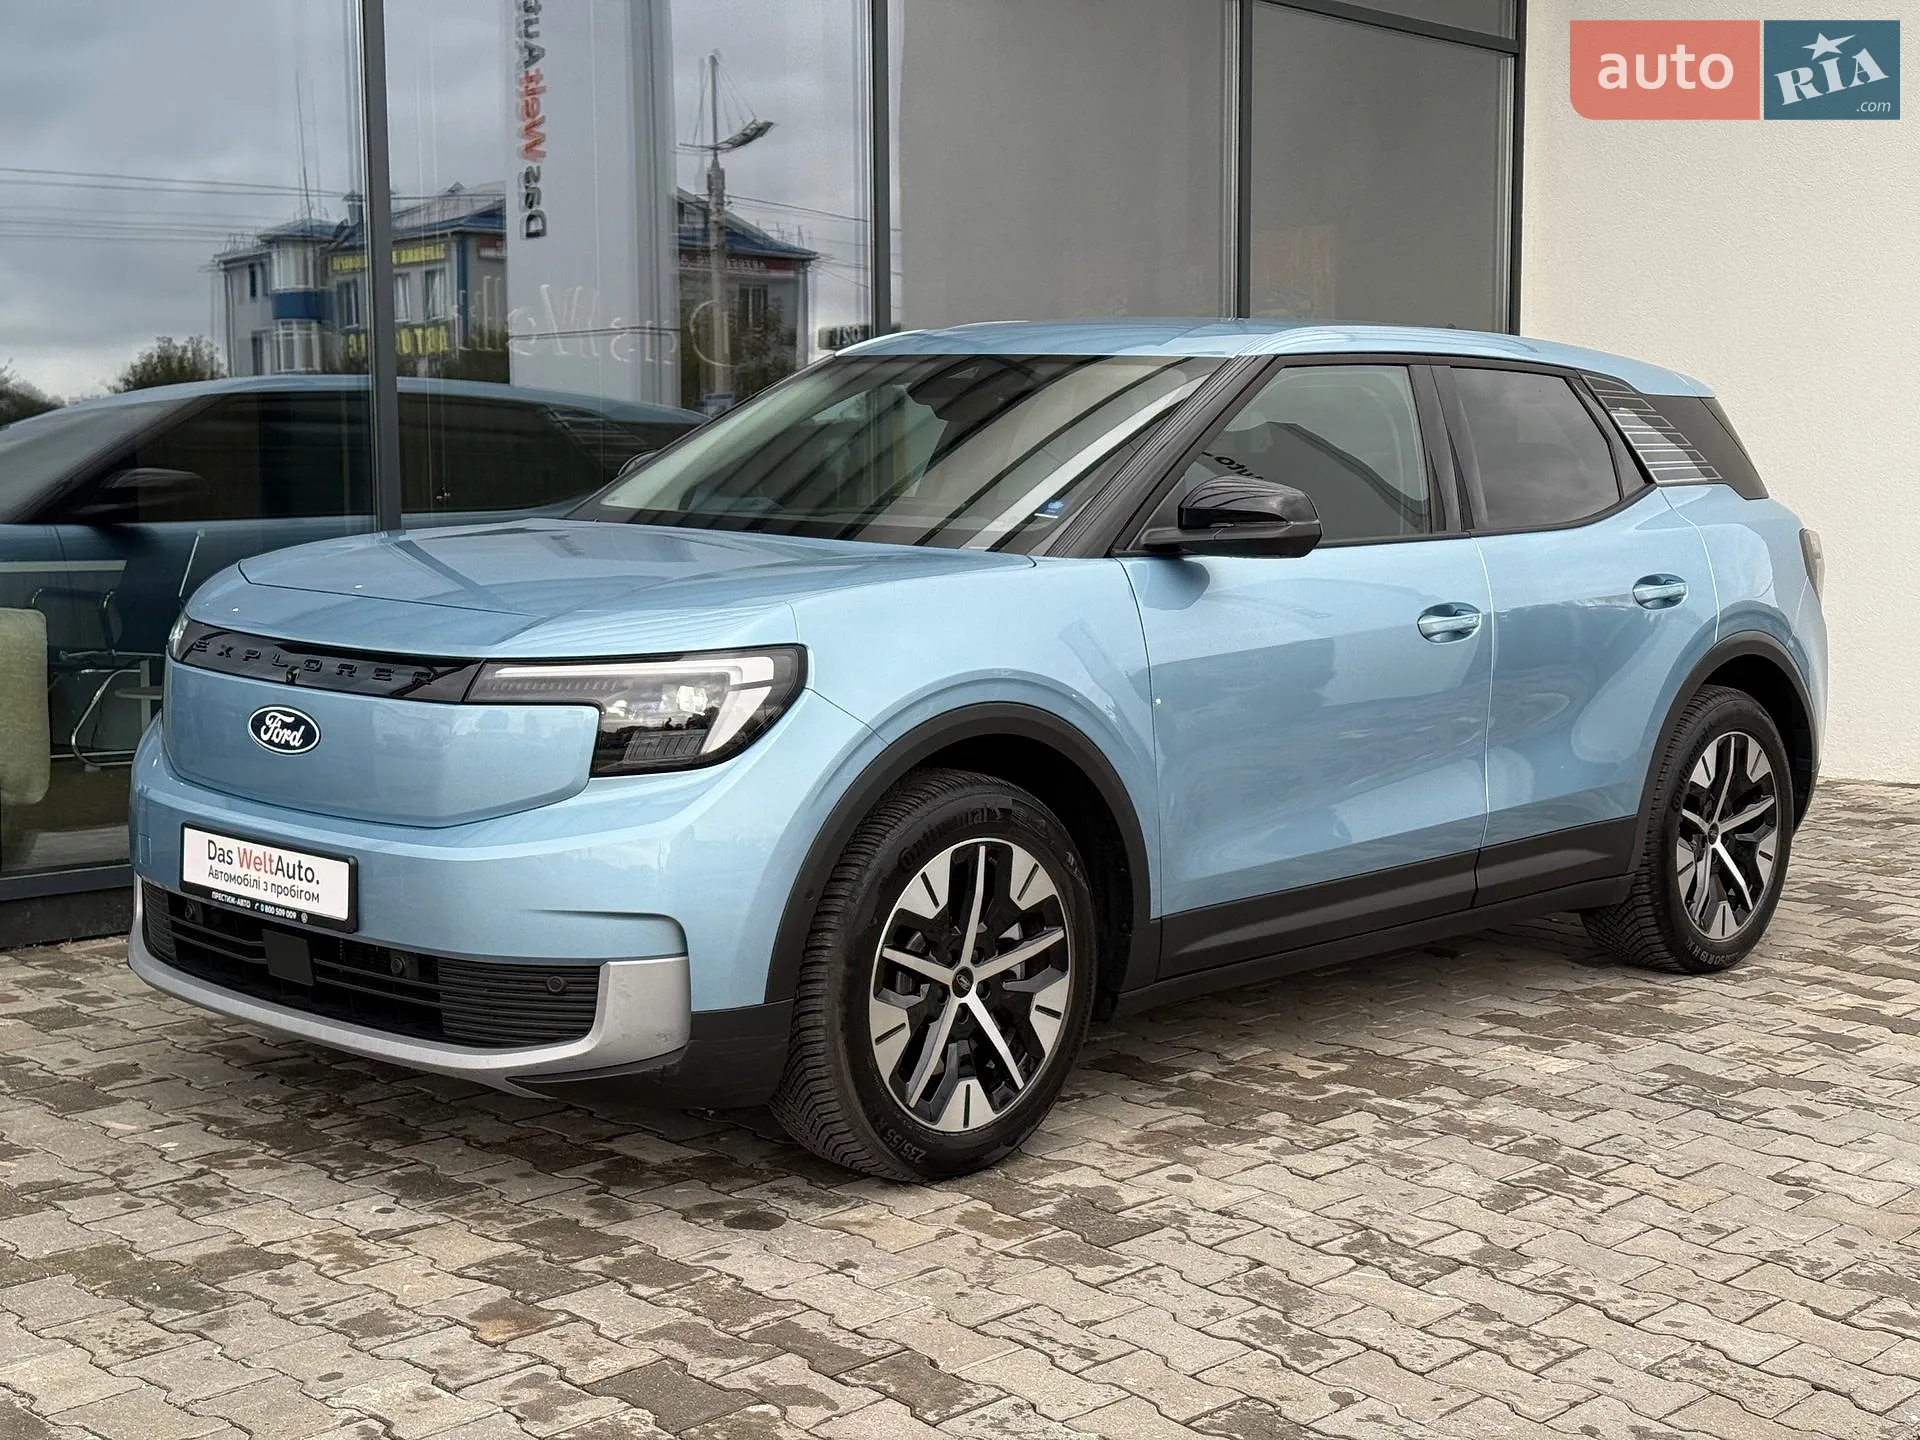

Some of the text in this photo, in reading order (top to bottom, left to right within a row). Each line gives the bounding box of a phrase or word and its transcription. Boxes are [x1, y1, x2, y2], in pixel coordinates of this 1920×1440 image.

[193, 638, 434, 685] EXPLORER
[260, 711, 306, 748] Ford
[207, 839, 320, 885] Das WeltAuto.
[208, 864, 320, 903] Автомобілі з пробігом
[882, 1129, 928, 1164] 235/55
